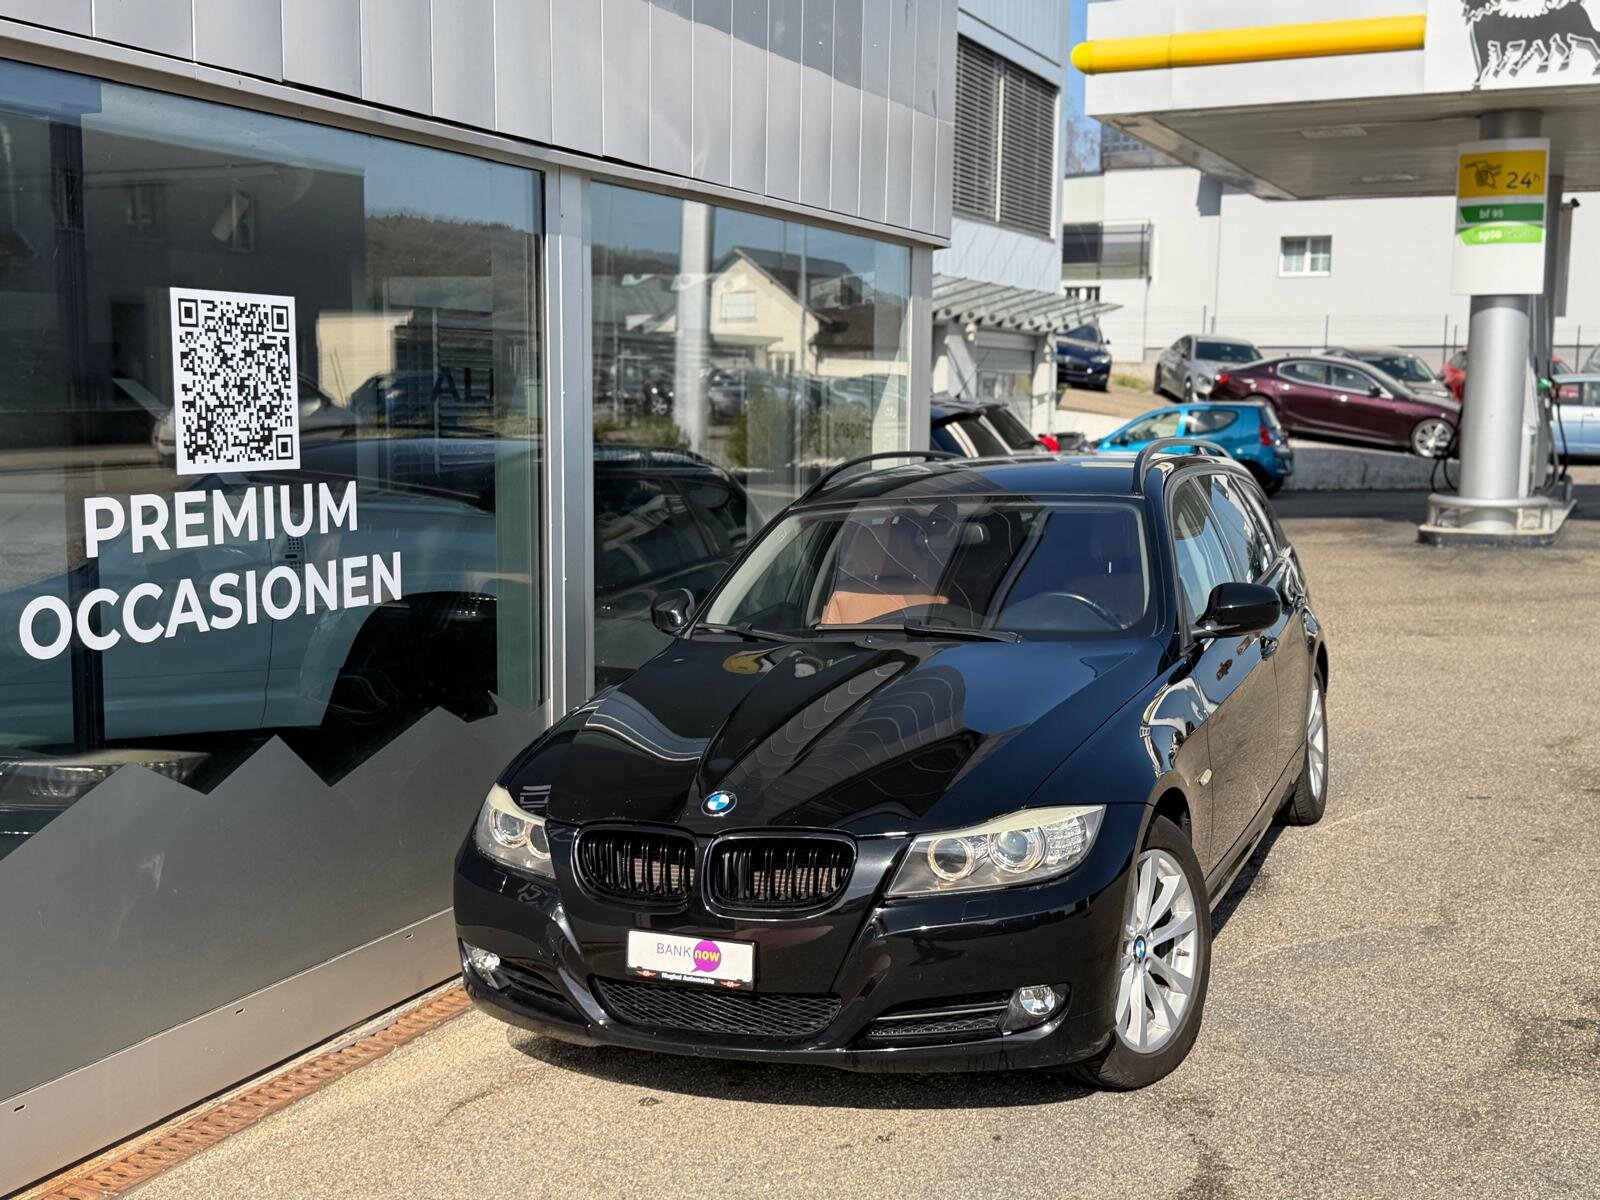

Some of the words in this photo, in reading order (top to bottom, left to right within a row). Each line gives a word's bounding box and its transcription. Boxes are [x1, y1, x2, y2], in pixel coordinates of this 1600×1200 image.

[84, 481, 357, 558] PREMIUM
[19, 551, 402, 660] OCCASIONEN
[656, 942, 691, 958] BANK
[694, 950, 719, 962] now
